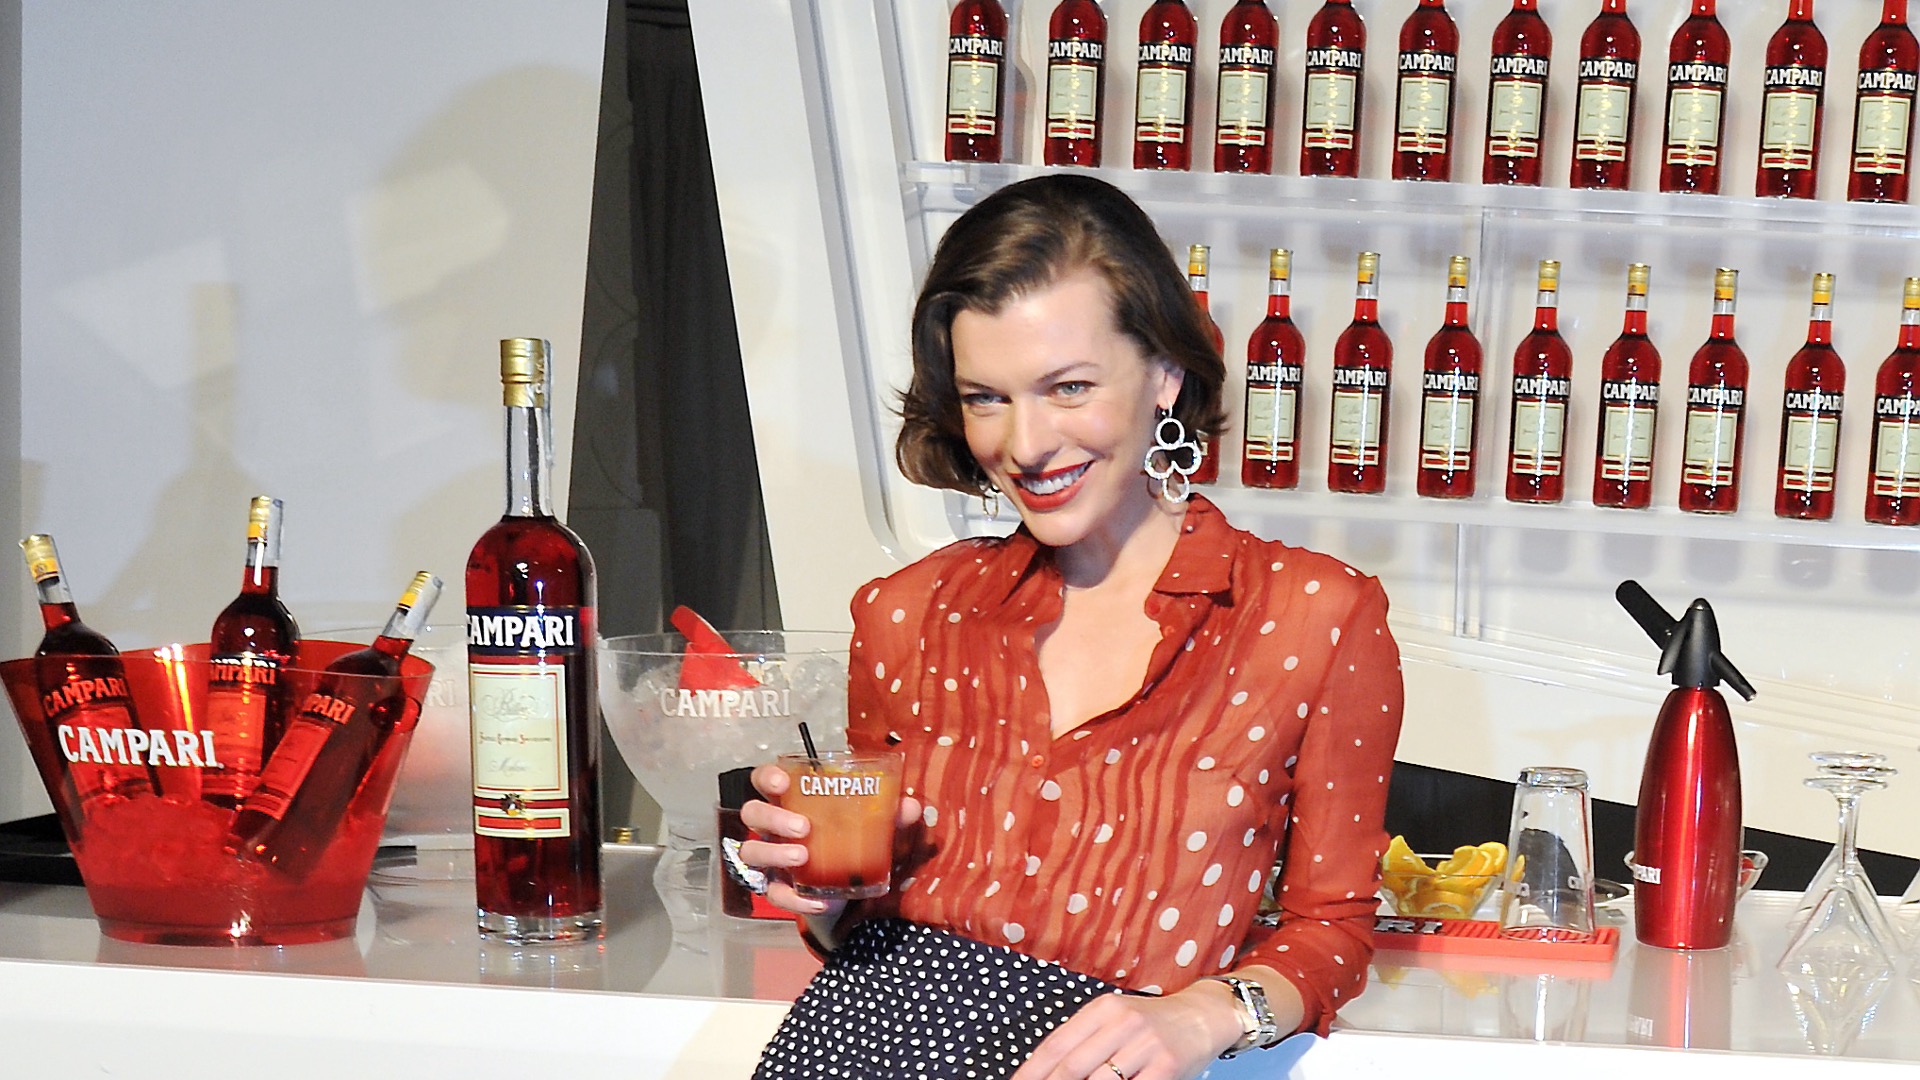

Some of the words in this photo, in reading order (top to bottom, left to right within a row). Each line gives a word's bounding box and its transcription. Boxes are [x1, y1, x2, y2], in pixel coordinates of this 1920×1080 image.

[1307, 50, 1361, 68] CAMPARI
[1400, 53, 1454, 71] CAMPARI
[1492, 57, 1547, 75] CAMPARI
[1580, 60, 1636, 78] CAMPARI
[1670, 65, 1726, 83] CAMPARI
[1766, 69, 1822, 87] CAMPARI
[1858, 73, 1916, 91] CAMPARI
[43, 677, 128, 718] CAMPARI
[660, 688, 790, 718] CAMPARI
[800, 775, 881, 797] CAMPARI
